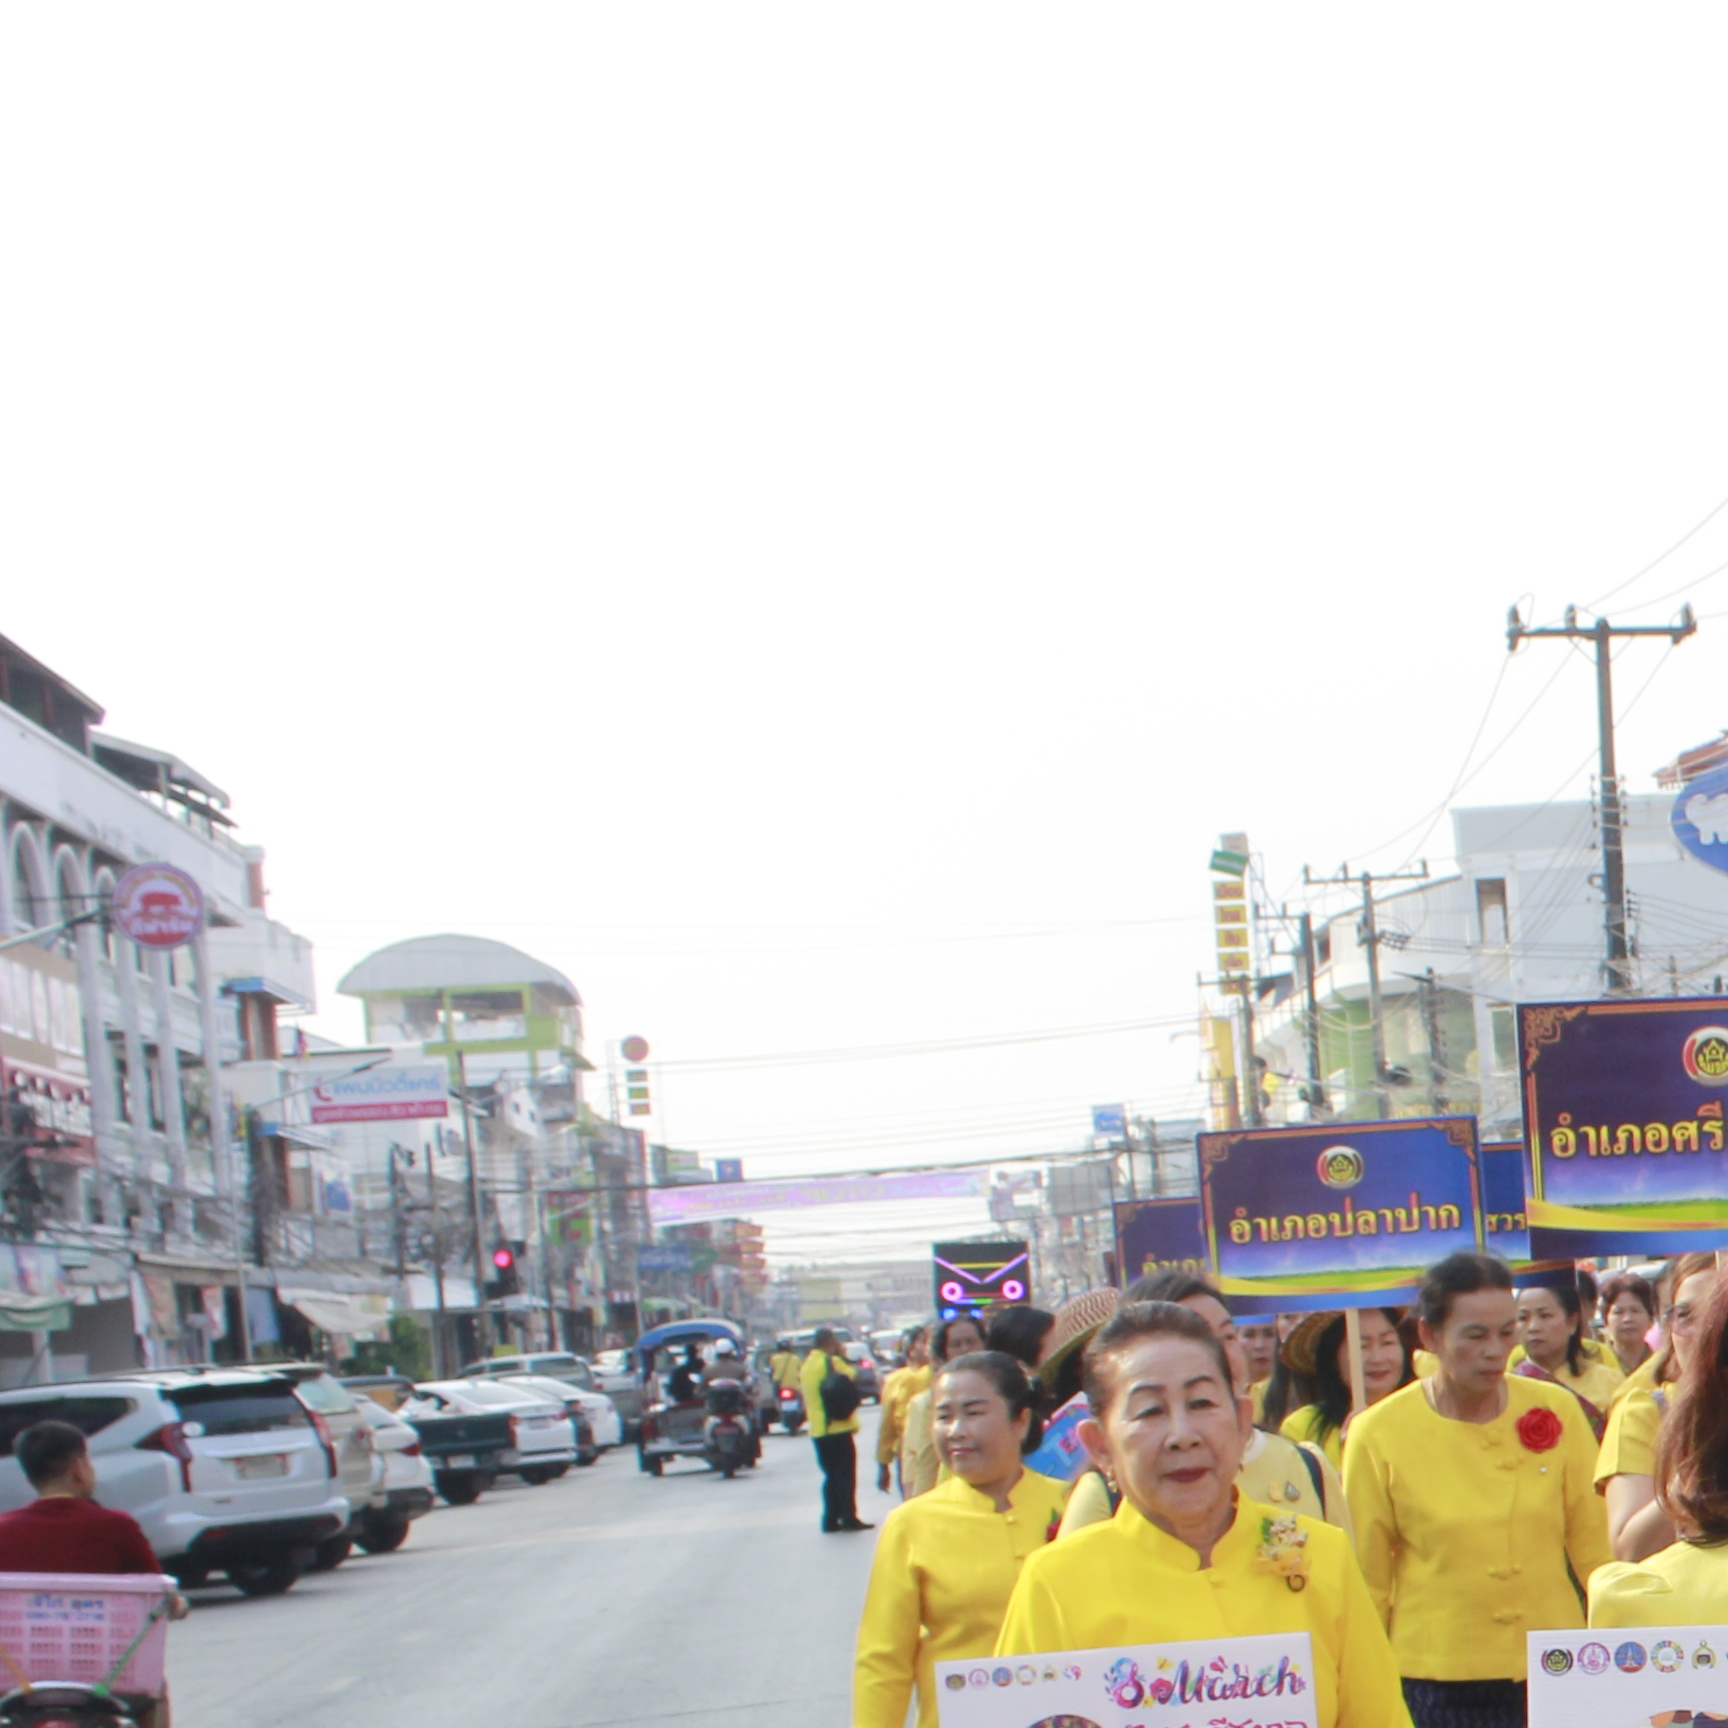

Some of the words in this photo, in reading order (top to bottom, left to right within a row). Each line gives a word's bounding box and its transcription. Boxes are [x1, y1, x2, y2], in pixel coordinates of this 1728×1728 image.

[1229, 1191, 1461, 1244] อำเภอปลาปาก
[1111, 1657, 1146, 1709] 8
[1155, 1655, 1302, 1706] March
